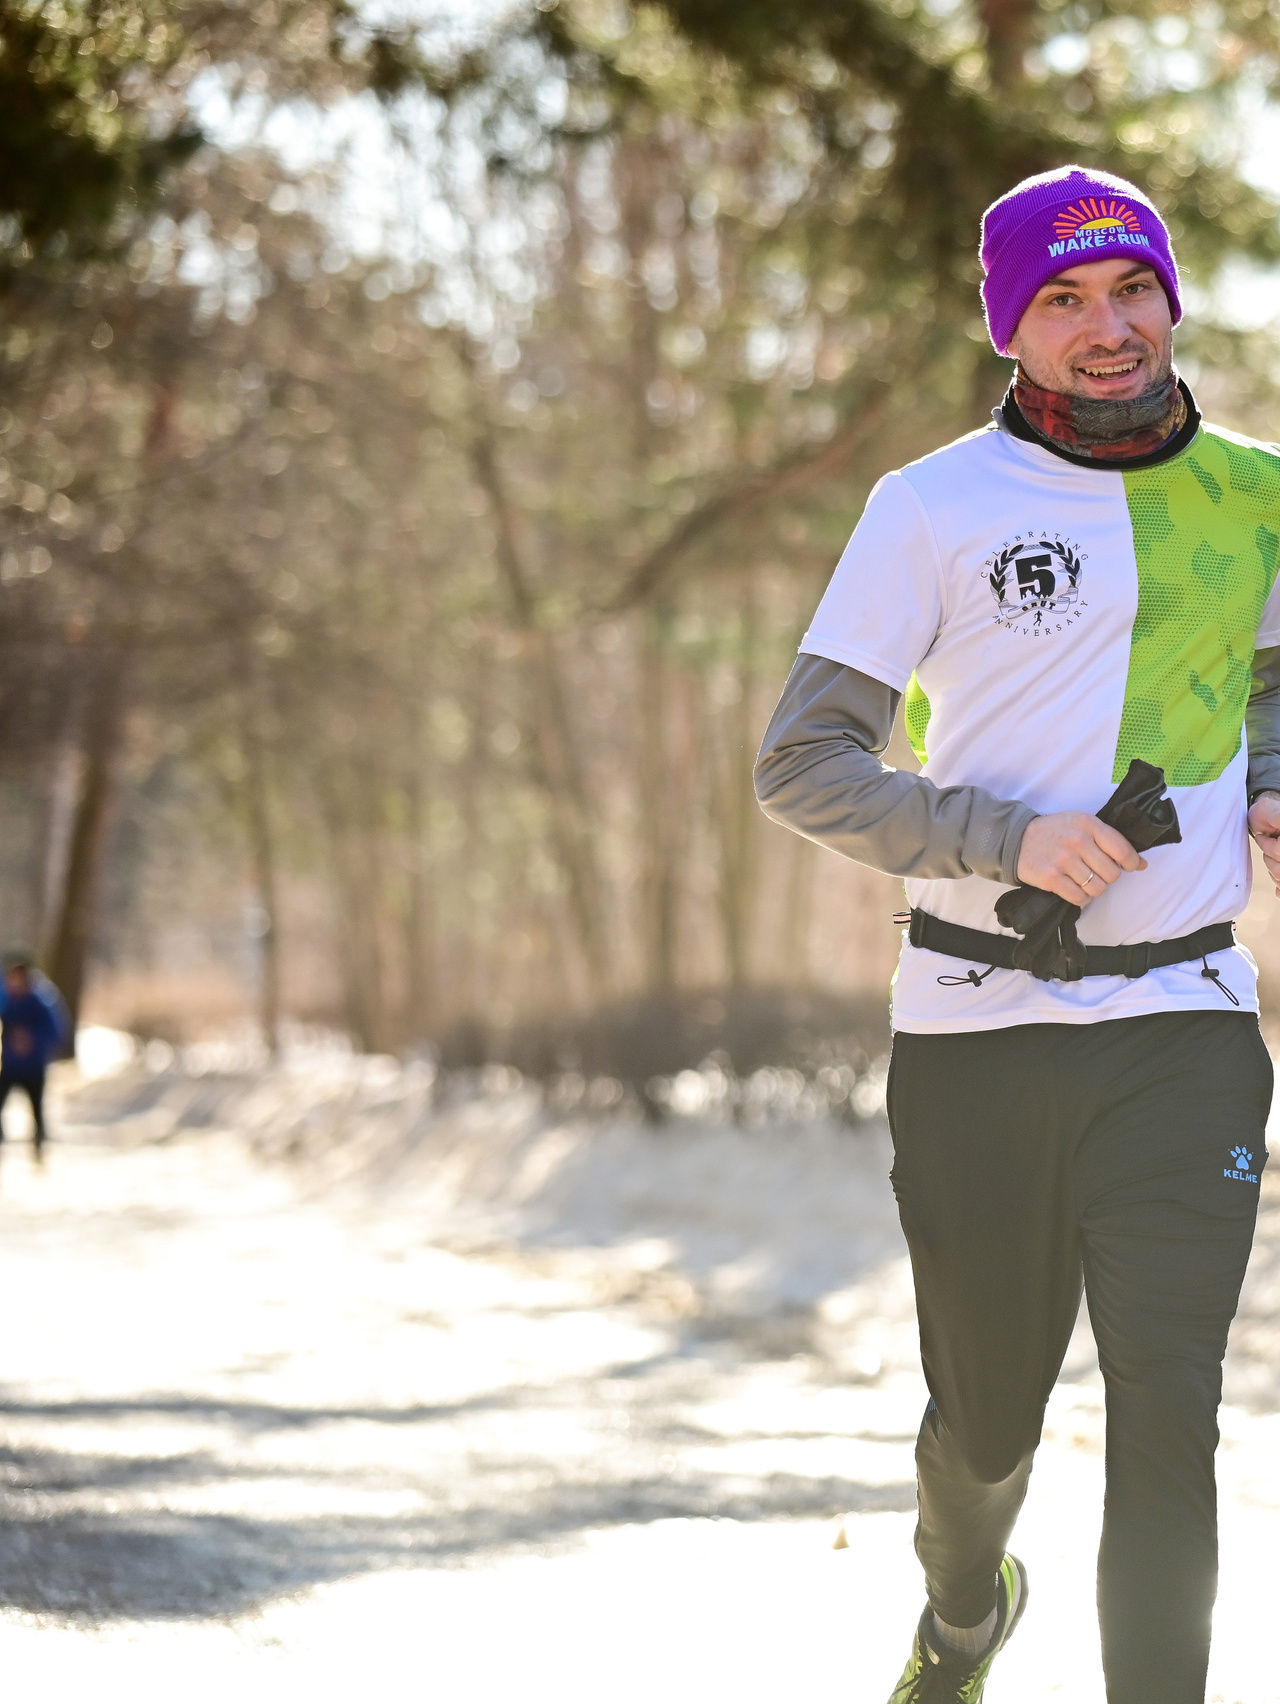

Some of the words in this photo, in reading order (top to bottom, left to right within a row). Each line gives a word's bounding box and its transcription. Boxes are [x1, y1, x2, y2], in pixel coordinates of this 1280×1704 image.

[1048, 235, 1108, 258] WAKE
[1117, 233, 1150, 248] RUN
[1075, 225, 1126, 238] MOSCOW
[980, 531, 1089, 579] CELEBRATING
[1015, 553, 1056, 600] 5
[992, 600, 1088, 637] ANNIVERSARY
[1223, 1168, 1258, 1184] KELME
